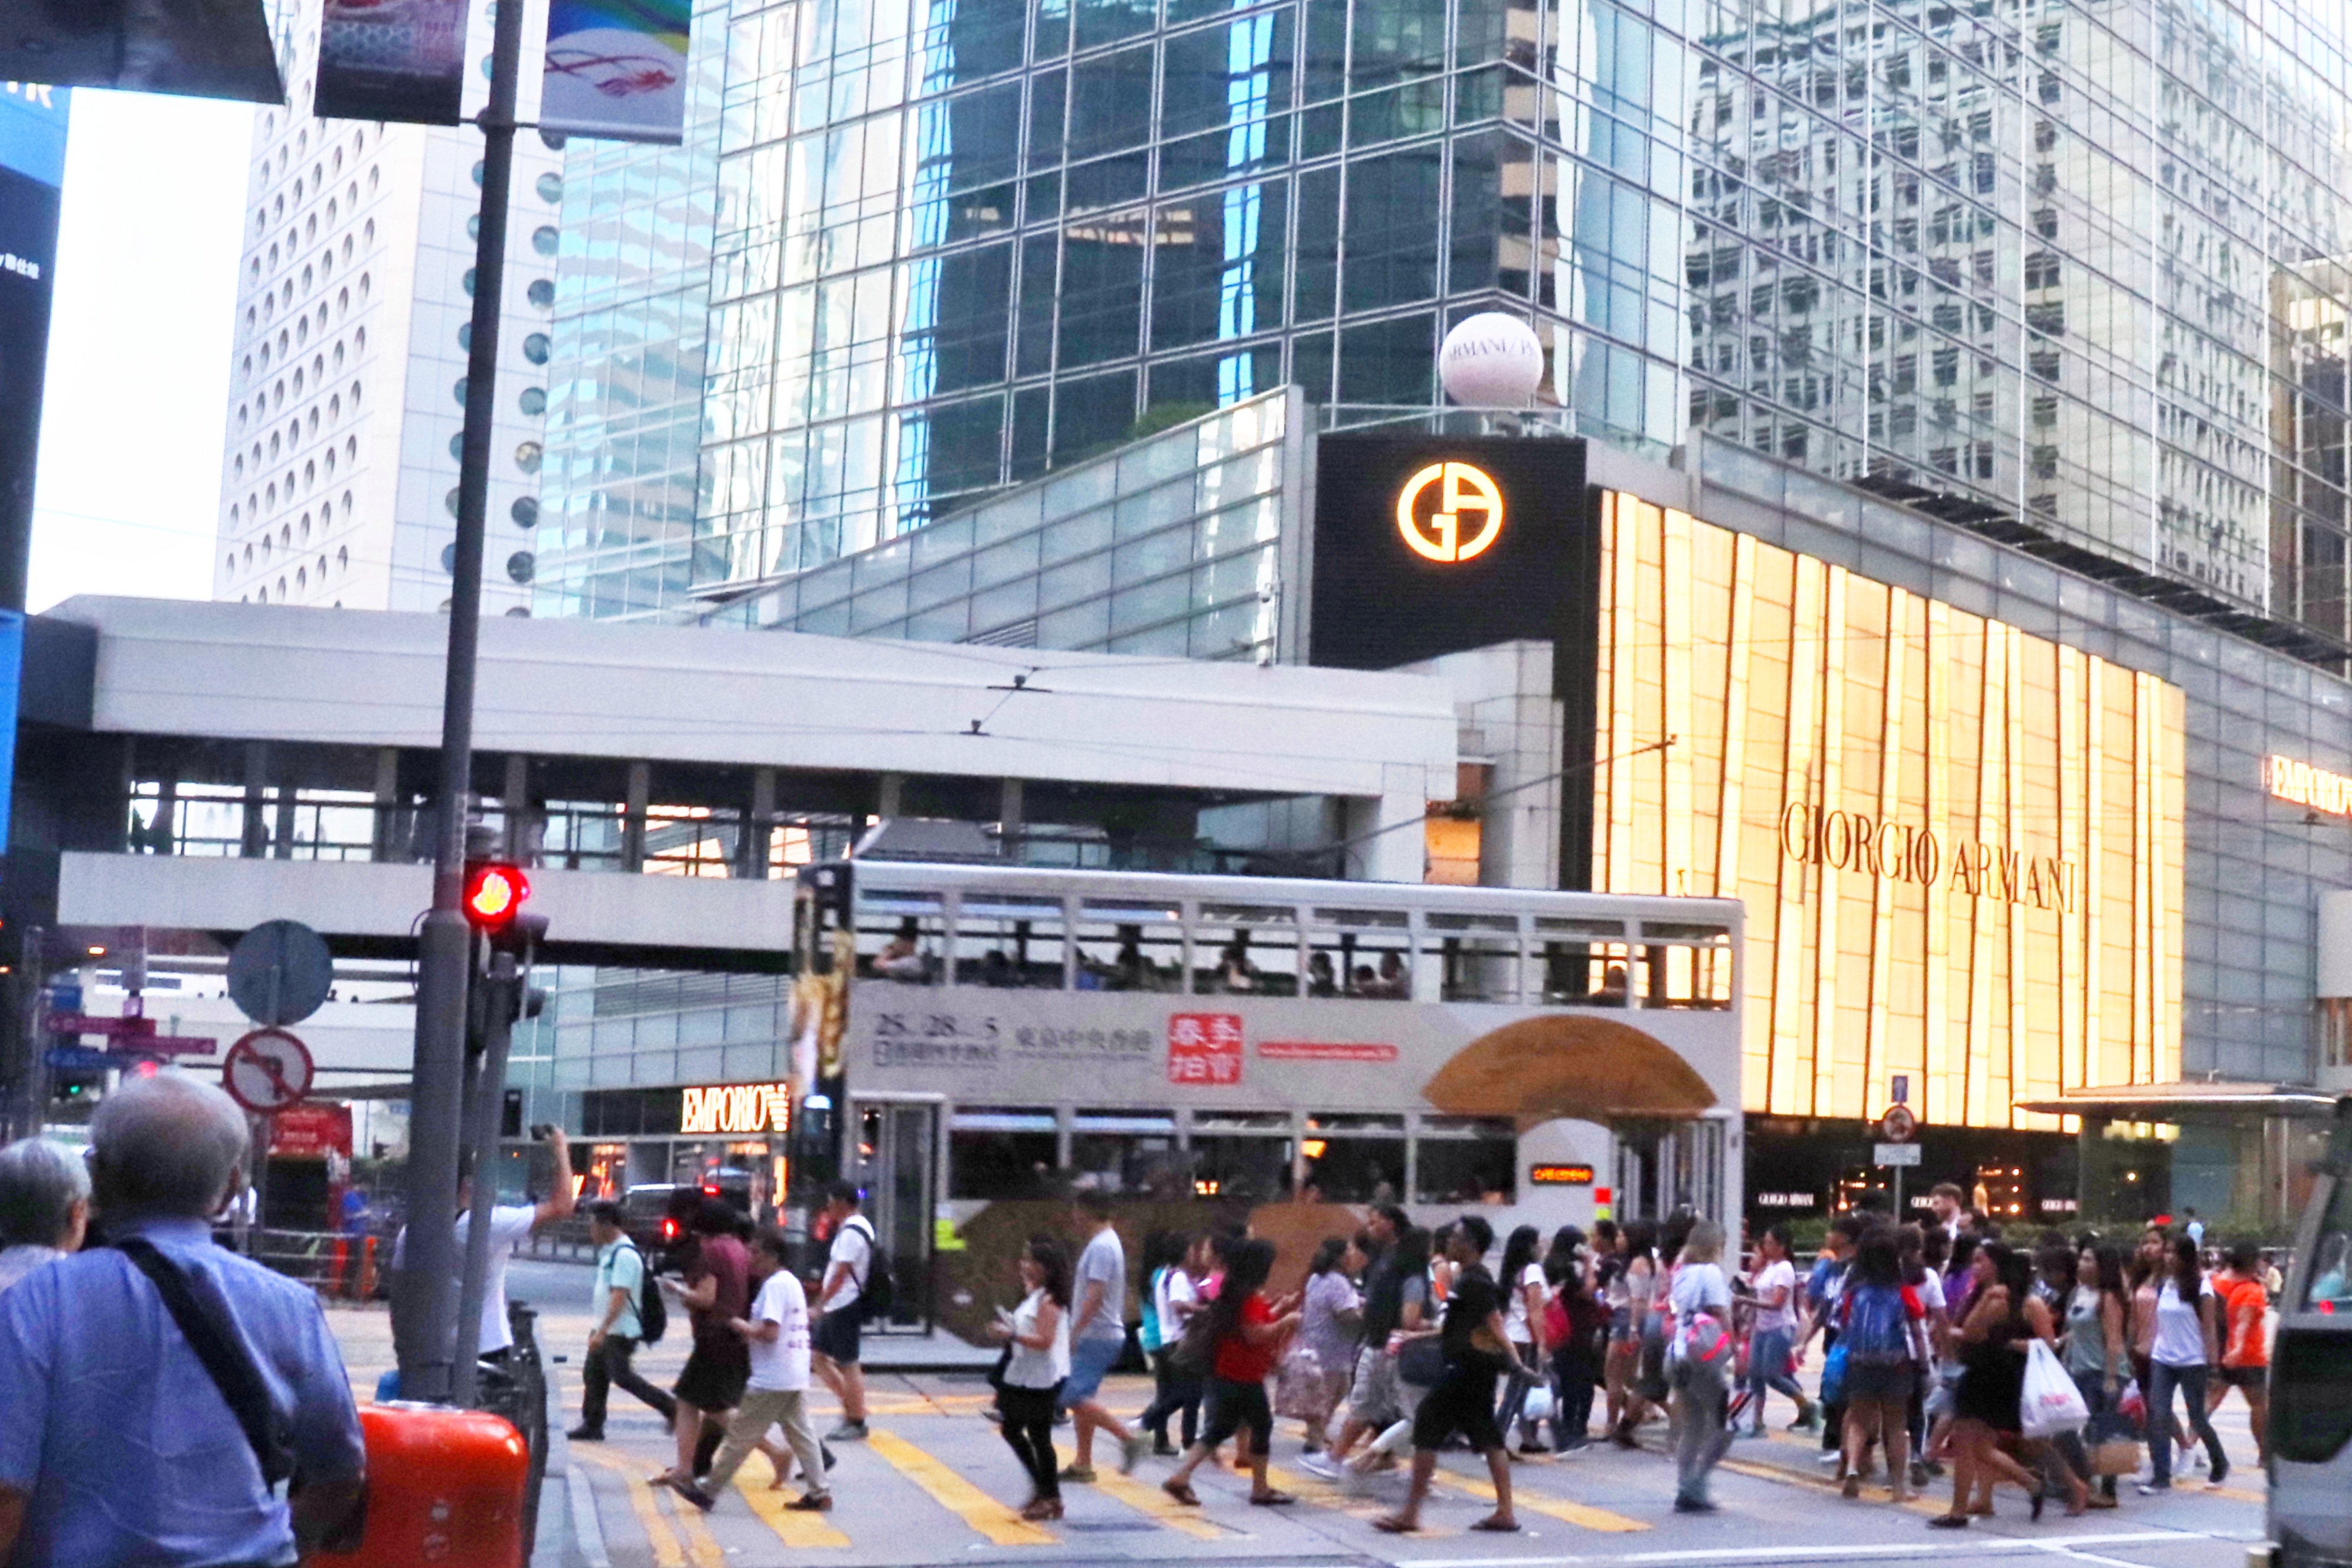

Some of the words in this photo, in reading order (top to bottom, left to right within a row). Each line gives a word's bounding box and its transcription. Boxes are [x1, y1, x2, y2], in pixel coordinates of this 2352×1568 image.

[1781, 802, 1939, 887] GIORGIO
[1949, 837, 2077, 914] ARMANI
[681, 1085, 767, 1133] EMPORIO
